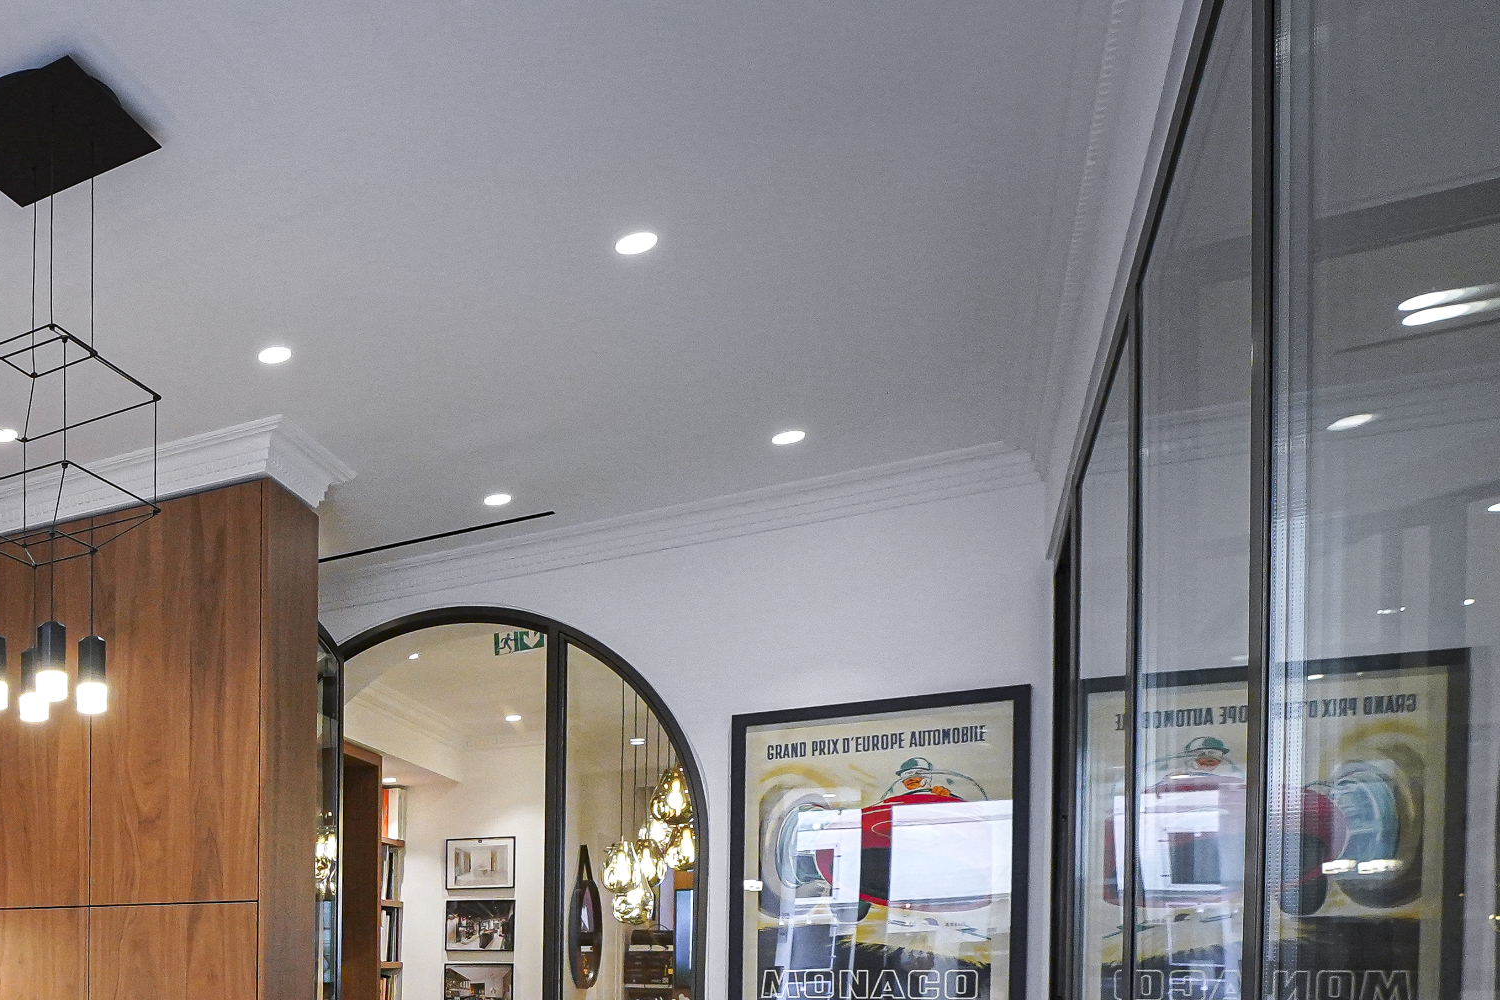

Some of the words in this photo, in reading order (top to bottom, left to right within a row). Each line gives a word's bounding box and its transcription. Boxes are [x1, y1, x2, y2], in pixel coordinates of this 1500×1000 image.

[767, 741, 807, 760] GRAND
[811, 738, 840, 757] PRIX
[842, 731, 905, 754] D'EUROPE
[909, 724, 987, 748] AUTOMOBILE
[761, 969, 979, 1000] MONACO
